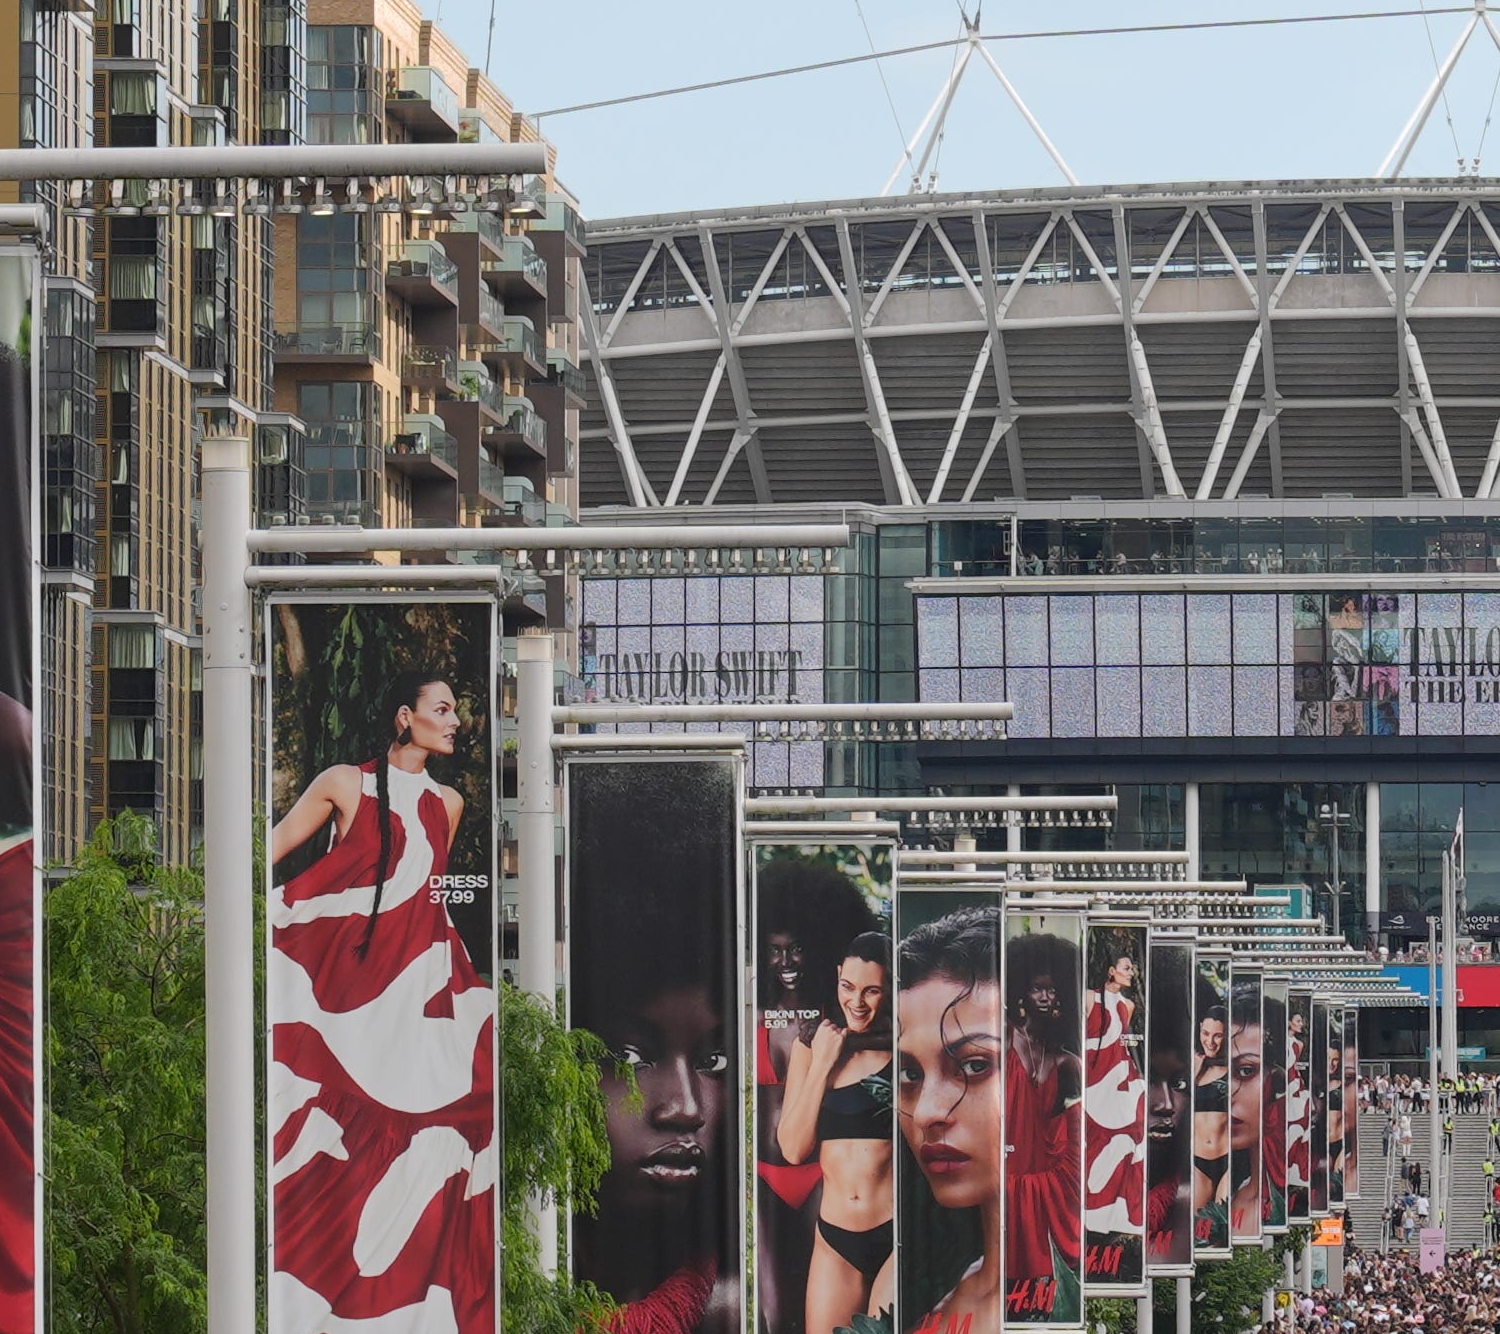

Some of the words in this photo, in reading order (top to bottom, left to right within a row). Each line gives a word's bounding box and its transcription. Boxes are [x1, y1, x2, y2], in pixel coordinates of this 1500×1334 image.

[600, 651, 707, 699] TAYLOR
[715, 651, 803, 697] SWIFT
[1405, 680, 1465, 703] THE
[429, 874, 489, 889] DRESS
[429, 890, 475, 905] 37.99
[764, 1009, 795, 1019] BIKINI
[797, 1009, 820, 1019] TOP
[764, 1020, 788, 1029] 5.99
[1007, 1279, 1058, 1314] H&M
